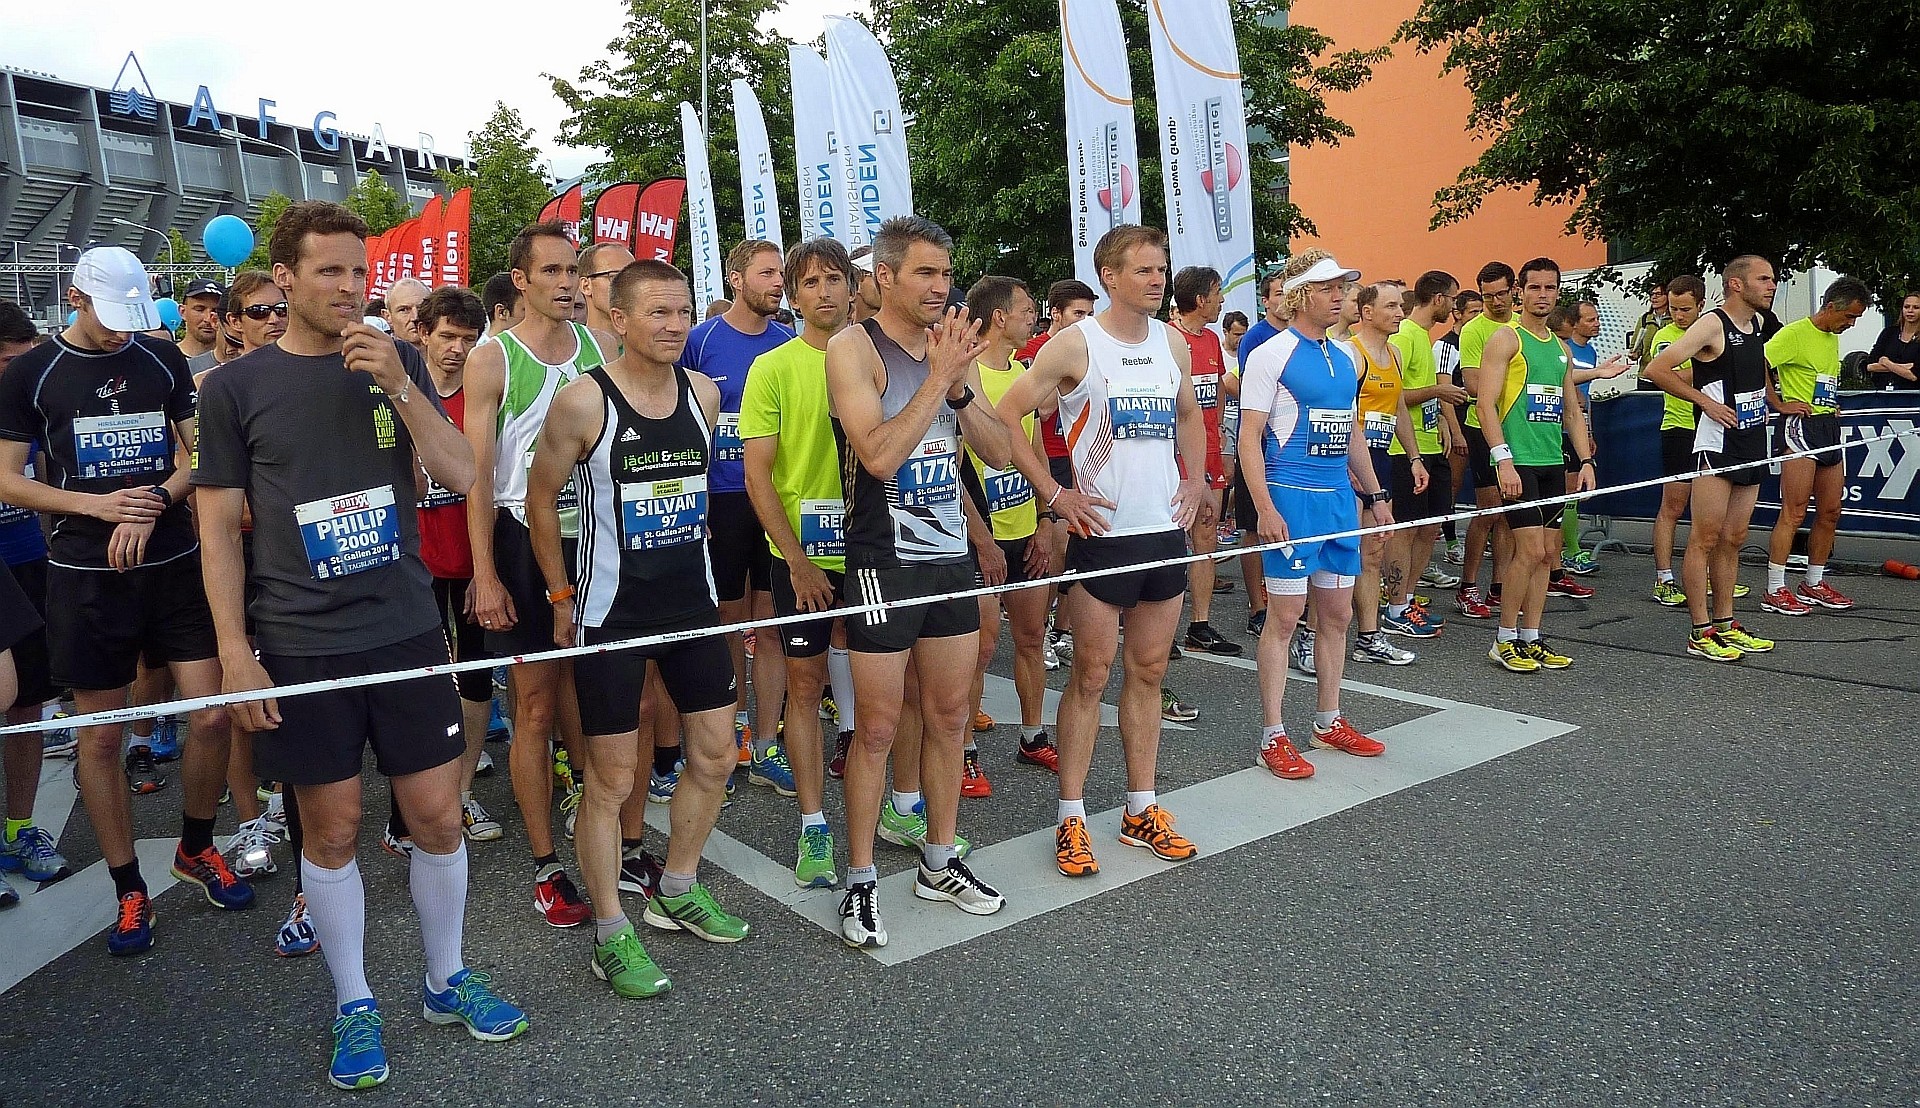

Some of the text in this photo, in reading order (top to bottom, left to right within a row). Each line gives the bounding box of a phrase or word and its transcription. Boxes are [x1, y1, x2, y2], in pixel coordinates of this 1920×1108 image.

[420, 237, 433, 292] llen
[443, 231, 459, 288] llen
[1121, 356, 1154, 366] Reebok
[1194, 384, 1217, 399] 1788
[1116, 397, 1172, 412] MARTIN
[1535, 394, 1560, 405] DIEGO
[373, 402, 392, 421] AUF
[1143, 411, 1151, 422] 7
[80, 428, 164, 448] FLORENS
[376, 427, 396, 438] LAUF
[718, 425, 741, 438] FLO
[108, 446, 142, 459] 1767
[623, 448, 702, 470] jäckli & seitz
[110, 459, 135, 467] Gallen
[135, 457, 152, 465] 2014
[910, 455, 957, 485] 1776
[635, 493, 697, 517] SILVAN
[316, 508, 387, 540] PHILIP
[661, 514, 678, 527] 97
[644, 524, 692, 539] St. Gallen 2014
[337, 530, 380, 552] 2000
[343, 548, 372, 561] Gallen
[371, 543, 389, 554] 2014
